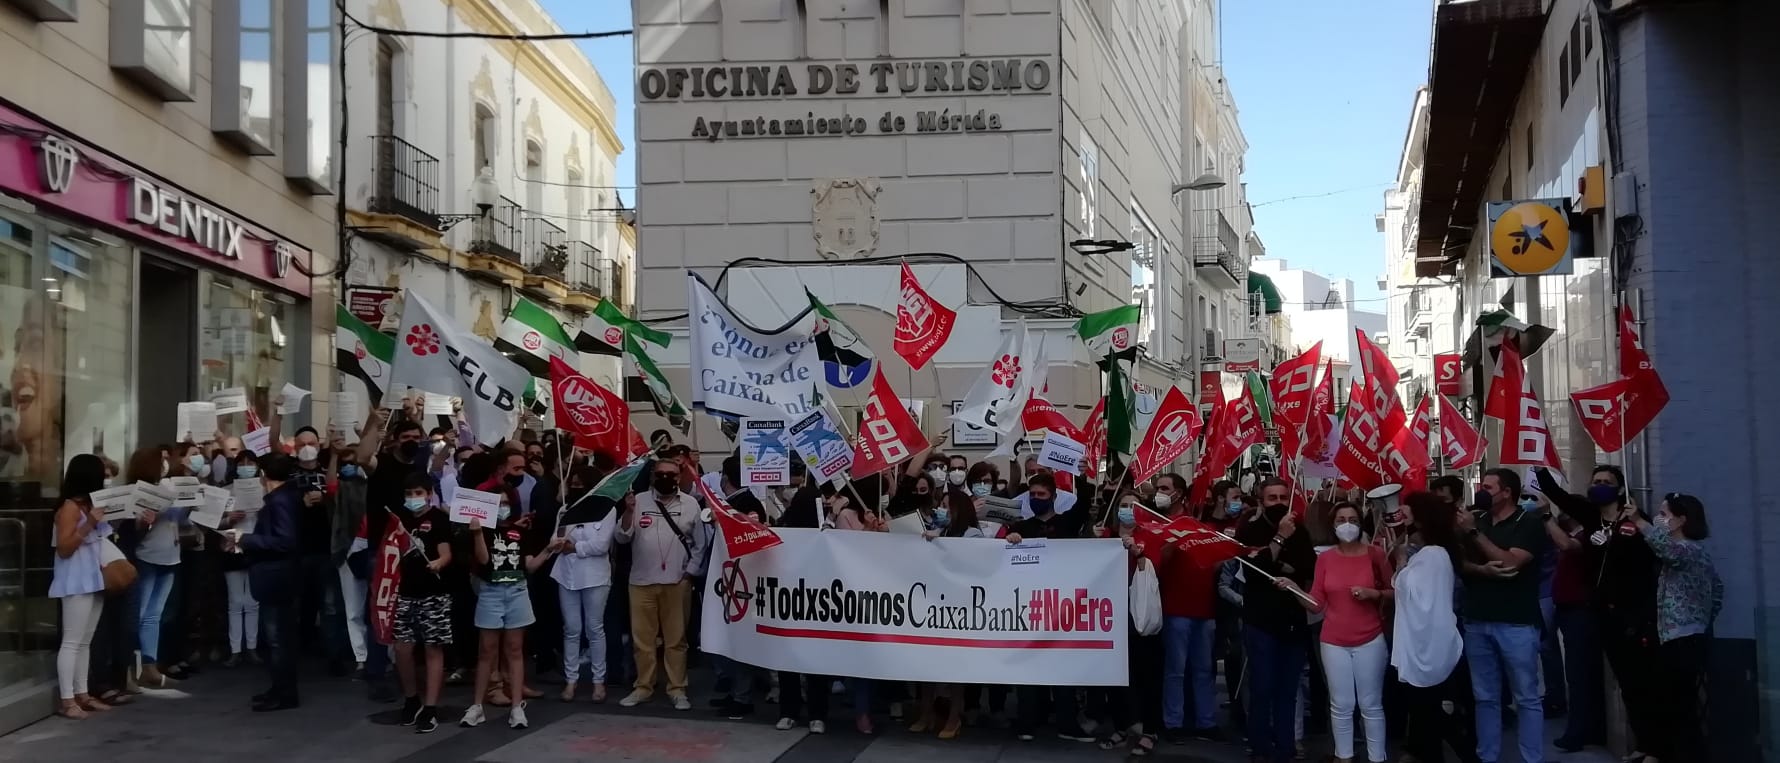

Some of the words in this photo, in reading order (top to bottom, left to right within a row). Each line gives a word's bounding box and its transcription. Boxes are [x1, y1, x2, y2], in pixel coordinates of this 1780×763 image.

[640, 66, 797, 99] OFICINA
[807, 63, 860, 95] DE
[870, 58, 1051, 94] TURISMO
[692, 111, 867, 142] Ayuntamiento
[879, 111, 905, 132] de
[917, 108, 1002, 132] Mérida
[133, 177, 244, 261] DENTIX
[780, 362, 809, 385] de
[1440, 361, 1456, 380] S
[1049, 450, 1076, 464] #NoEre
[823, 459, 848, 475] CCOO
[752, 473, 780, 481] CCOO
[459, 505, 488, 517] #NoEre
[1011, 554, 1040, 562] #NoEre
[756, 577, 905, 627] #TodxsSomos
[907, 583, 1029, 633] CaixaBank
[1029, 588, 1114, 633] #NoEre
